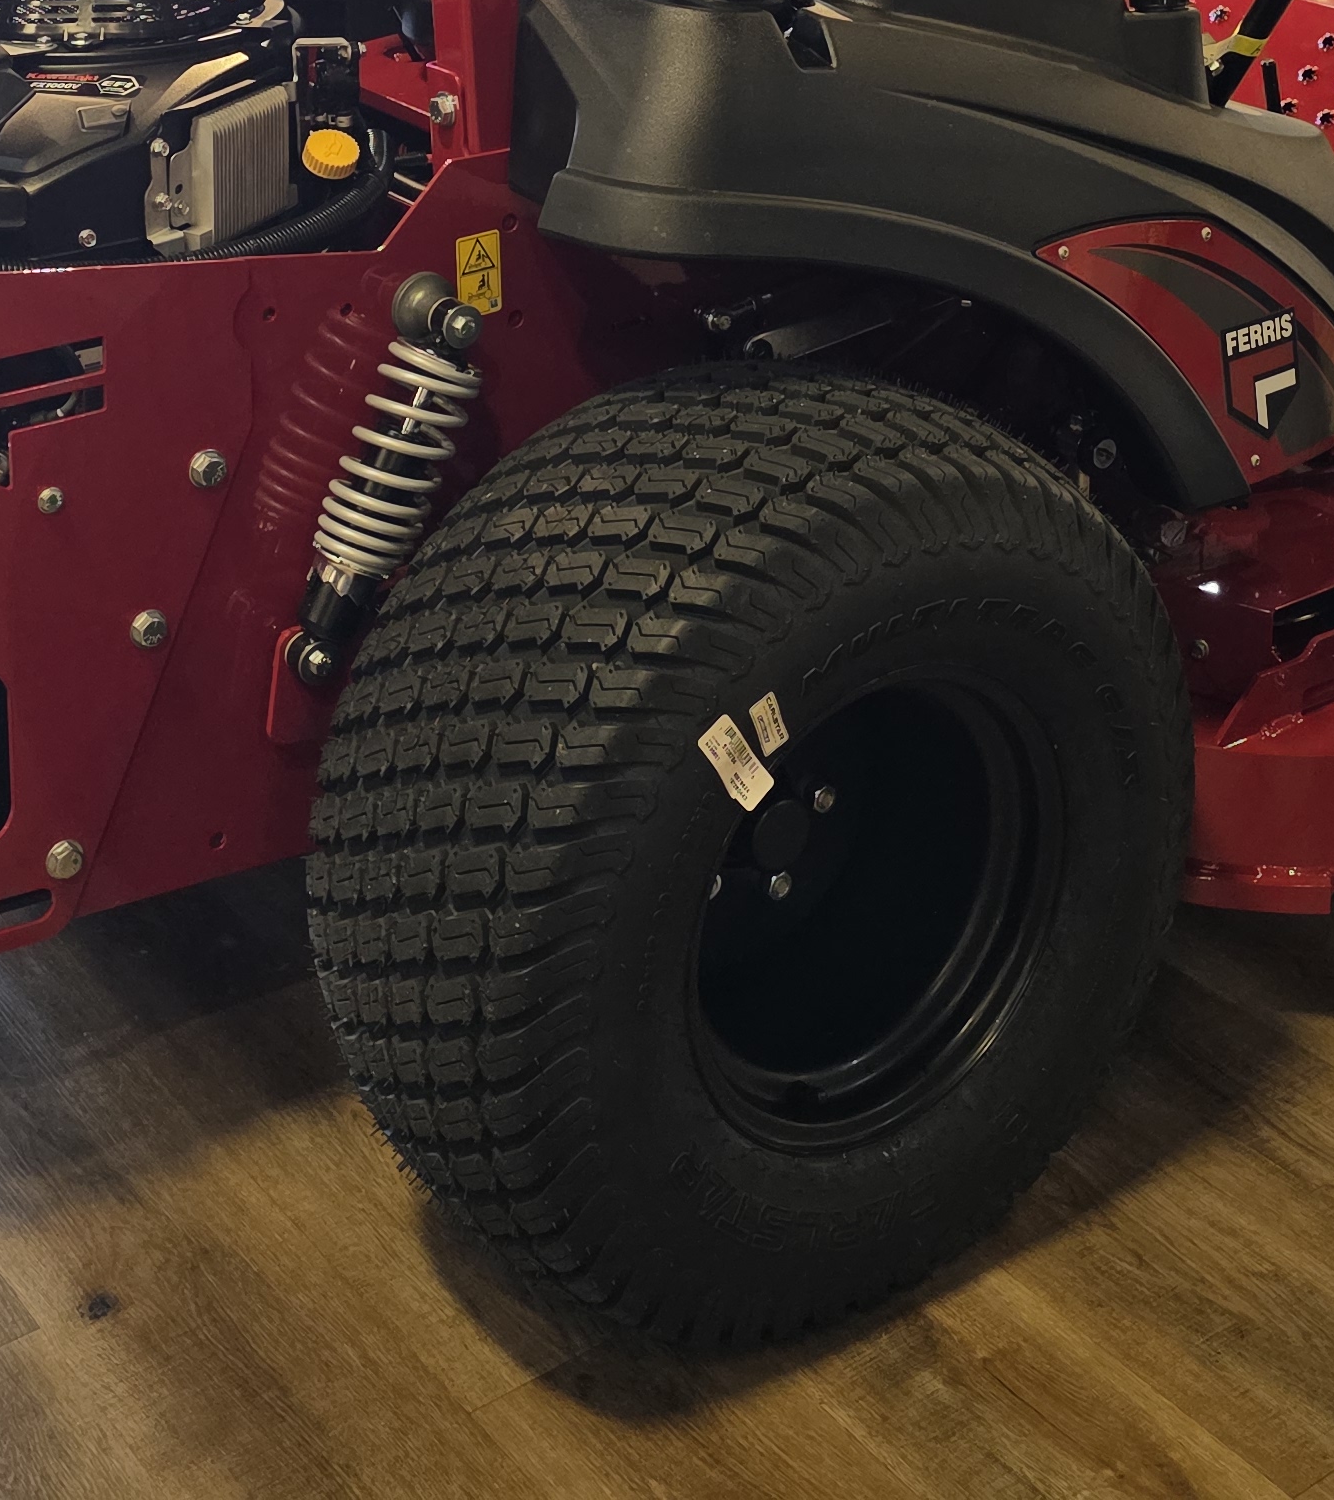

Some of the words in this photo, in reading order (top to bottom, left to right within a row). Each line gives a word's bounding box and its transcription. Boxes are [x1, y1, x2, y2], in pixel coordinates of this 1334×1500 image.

[26, 72, 99, 82] Kawasaki
[30, 81, 82, 90] FX1000V
[1225, 312, 1293, 357] FERRIS
[765, 696, 785, 742] CARLSTAR
